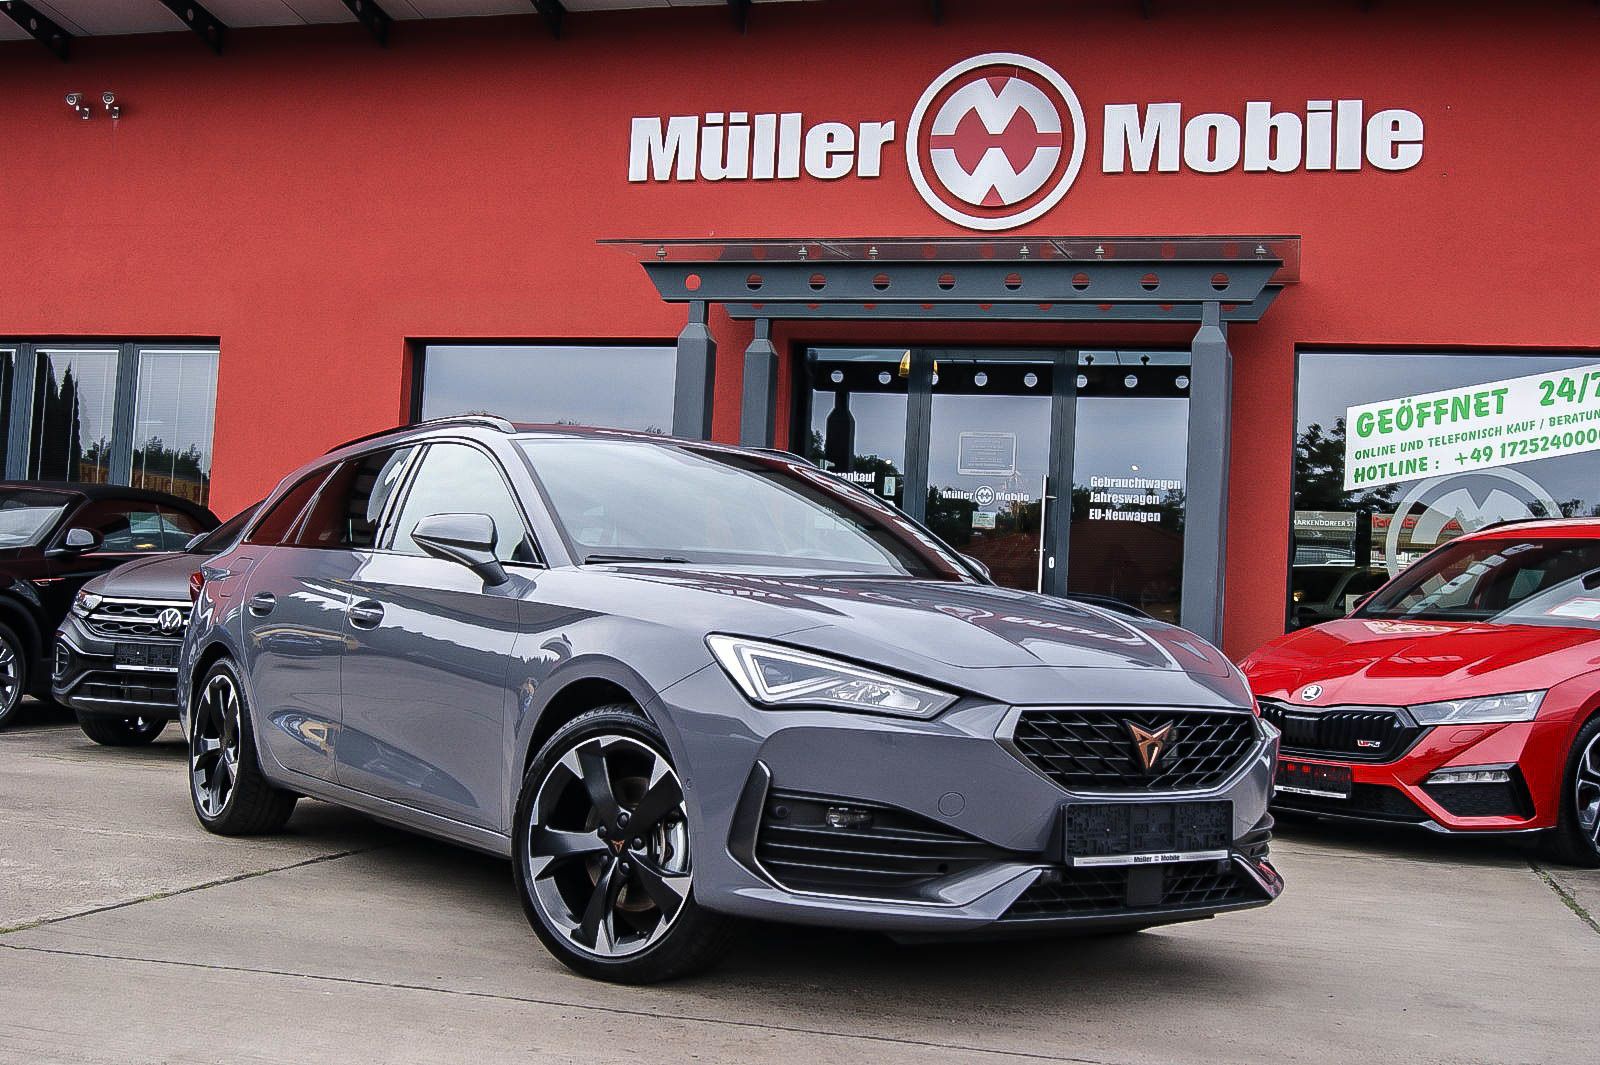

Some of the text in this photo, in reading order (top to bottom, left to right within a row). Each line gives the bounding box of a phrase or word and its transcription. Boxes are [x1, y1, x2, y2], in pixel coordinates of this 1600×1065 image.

[628, 111, 895, 182] Müller
[1102, 98, 1424, 174] Mobile
[1356, 387, 1509, 438] GEÖFFNET
[1354, 444, 1396, 460] ONLINE
[1400, 439, 1424, 453] UND
[1428, 425, 1502, 448] TELEFONISCH
[1506, 420, 1536, 435] KAUF
[1353, 456, 1428, 484] HOTLINE
[1454, 445, 1494, 466] +49
[1500, 428, 1600, 459] 172524000
[942, 490, 974, 500] Müller
[995, 491, 1030, 501] Mobile
[1090, 476, 1181, 491] Gebrauchtwagen
[1089, 491, 1160, 506] Jahreswagen
[1089, 508, 1161, 523] EU-Neuwagen
